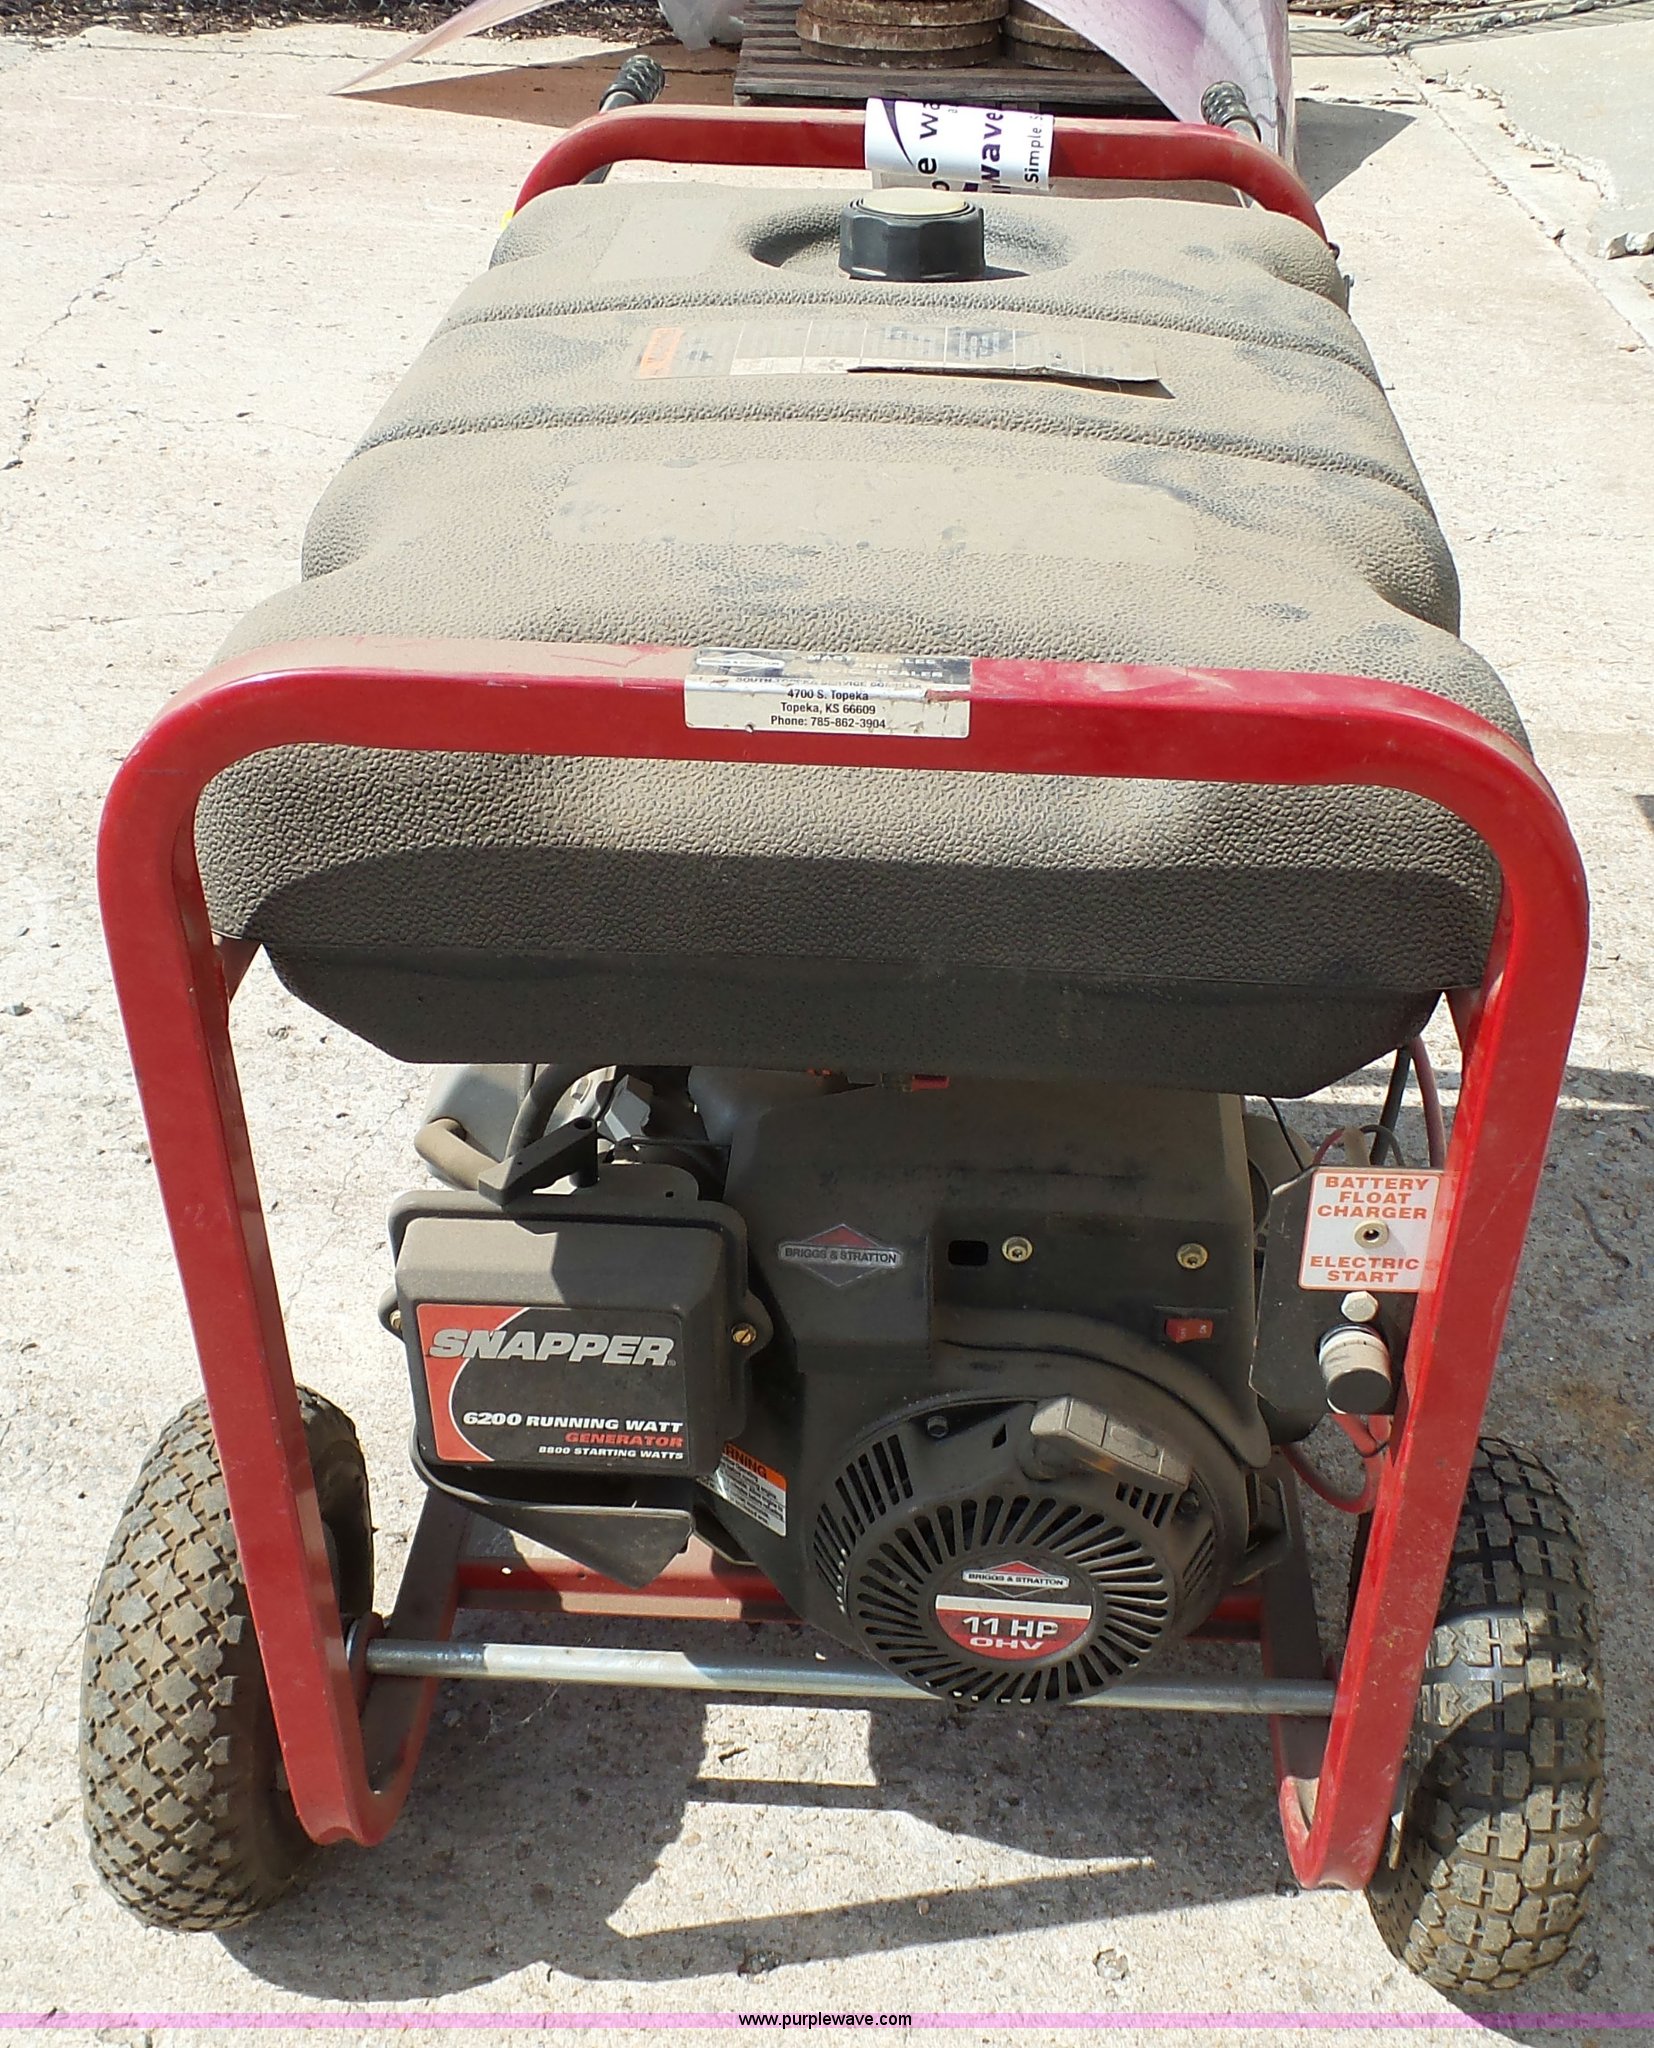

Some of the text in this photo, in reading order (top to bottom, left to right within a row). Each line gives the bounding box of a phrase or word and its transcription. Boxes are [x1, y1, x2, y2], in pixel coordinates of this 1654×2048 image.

[787, 689, 869, 702] 4700 S. Topeka
[781, 702, 876, 714] Topeka, KS 66609
[771, 716, 886, 728] Phone: 785-862-3904
[1325, 1176, 1429, 1190] BATTERY
[1339, 1191, 1411, 1204] FLOAT
[1317, 1205, 1427, 1219] CHARGER
[785, 1247, 897, 1263] BRIGGS & STRATTON
[1310, 1256, 1420, 1270] ELECTRIC
[1327, 1270, 1398, 1283] START
[429, 1328, 675, 1367] SNAPPER
[463, 1411, 684, 1433] 6200 RUNNING WATT
[565, 1432, 684, 1448] GENERATOR
[574, 1447, 636, 1458] STARTING
[640, 1450, 684, 1460] WATTS
[723, 1443, 767, 1480] RNING
[968, 1573, 1005, 1582] BRIGGS
[1015, 1576, 1064, 1586] STRATTON
[962, 1616, 1058, 1638] 11 HP
[969, 1637, 1044, 1650] OHV
